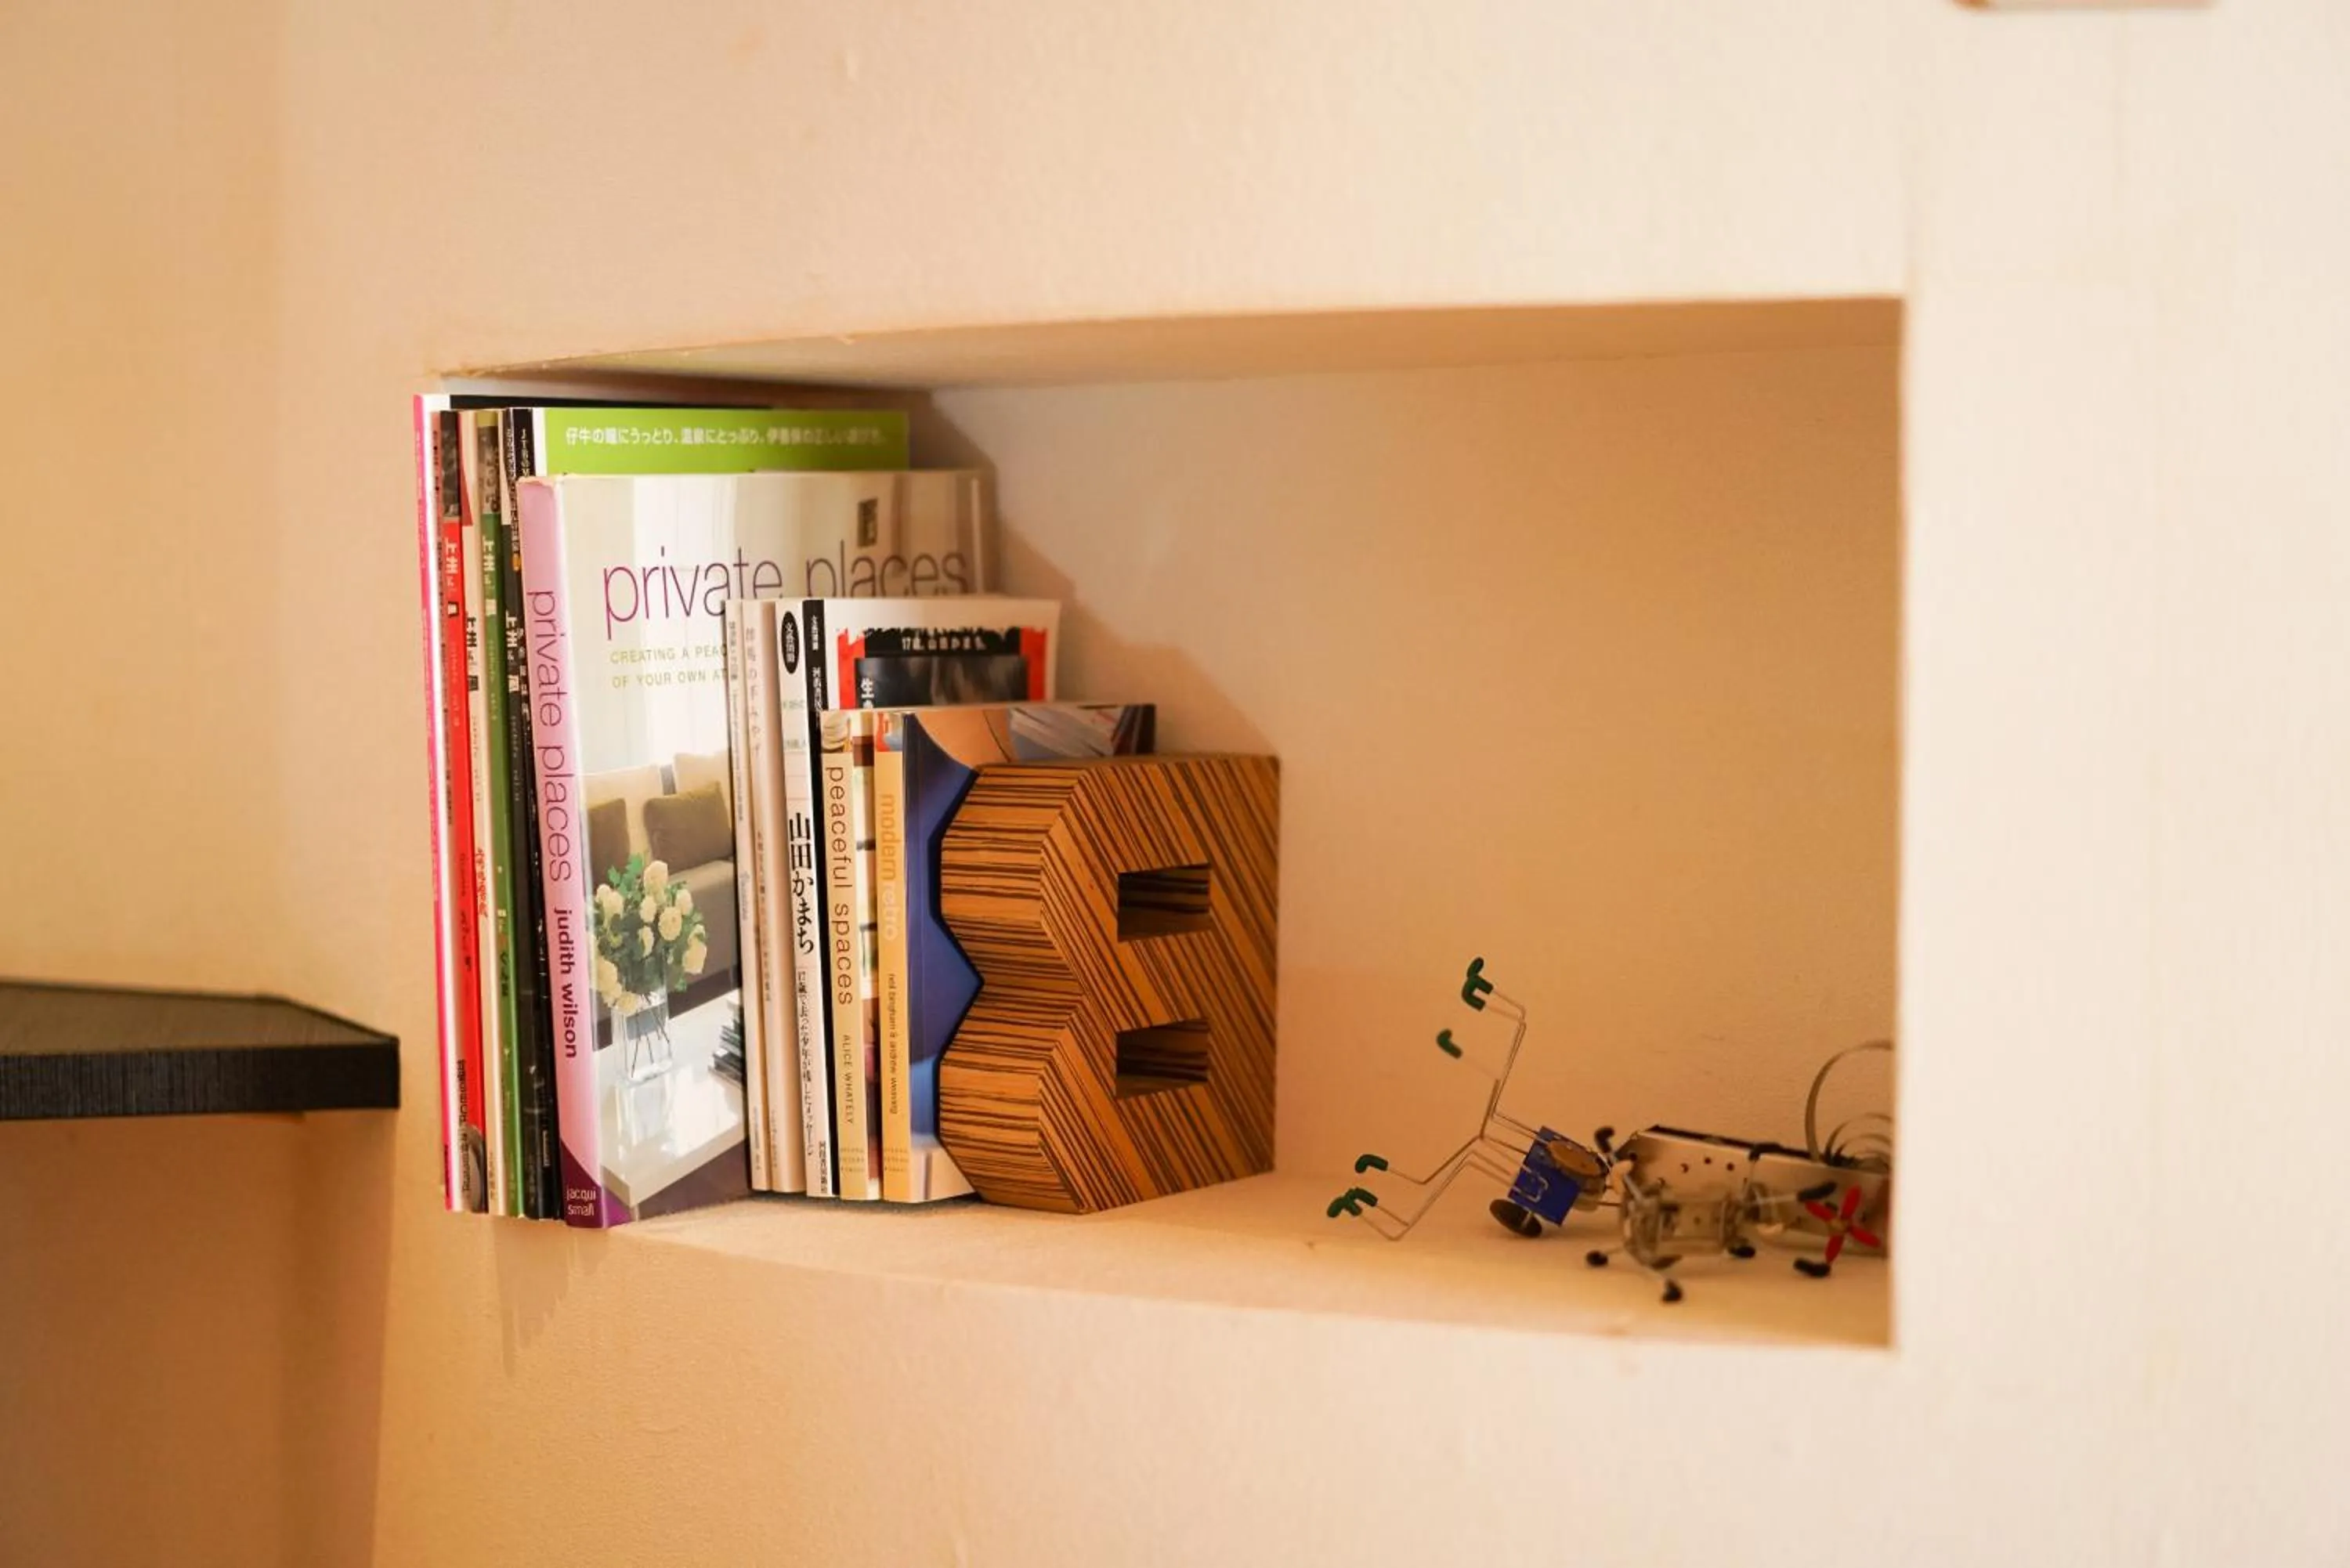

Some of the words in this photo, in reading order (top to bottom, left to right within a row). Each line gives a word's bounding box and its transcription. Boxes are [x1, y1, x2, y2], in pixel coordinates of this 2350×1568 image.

[603, 546, 783, 641] private
[806, 540, 968, 597] places
[526, 591, 567, 727] private
[609, 648, 675, 664] CREATING
[682, 648, 689, 659] A
[611, 675, 627, 688] OF
[635, 672, 671, 686] YOUR
[678, 670, 707, 684] OWN
[537, 746, 573, 881] places
[826, 766, 852, 888] peaceful
[880, 793, 900, 881] modern
[789, 812, 815, 955] 山田かまち
[554, 907, 577, 976] judith
[832, 903, 853, 1005] spaces
[561, 983, 578, 1058] wilson
[842, 1034, 851, 1071] ALICE
[844, 1072, 854, 1124] WHATELY
[566, 1187, 596, 1201] jacqui
[567, 1204, 595, 1216] small
